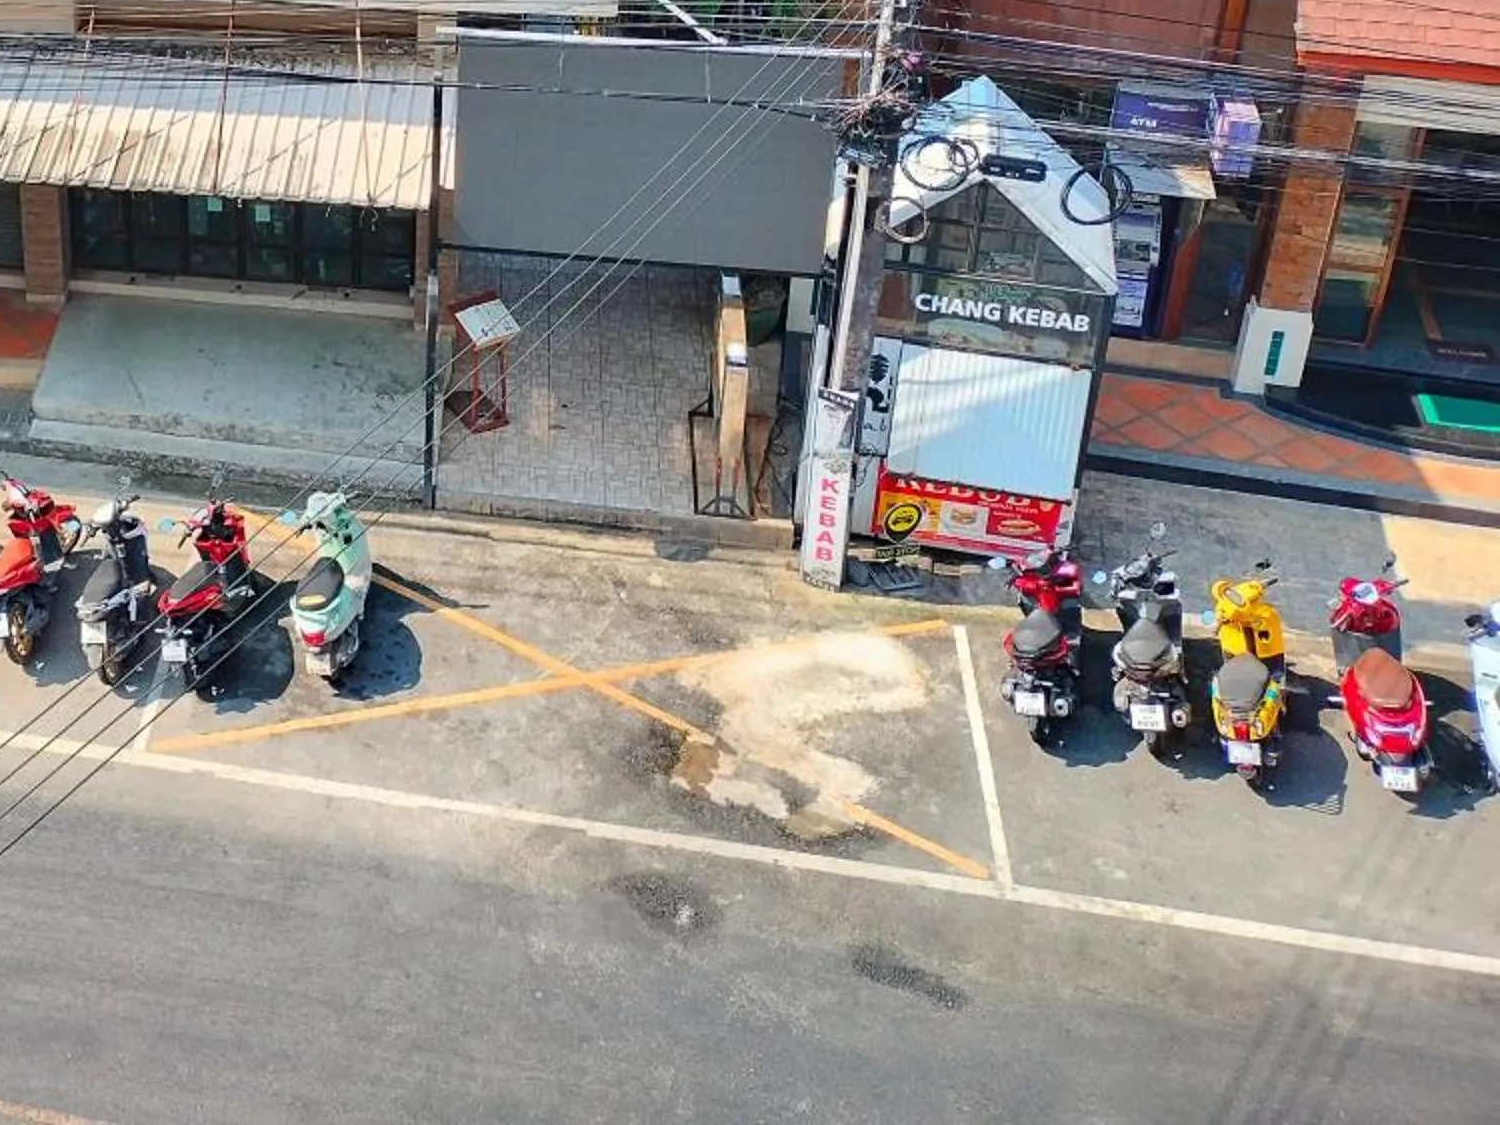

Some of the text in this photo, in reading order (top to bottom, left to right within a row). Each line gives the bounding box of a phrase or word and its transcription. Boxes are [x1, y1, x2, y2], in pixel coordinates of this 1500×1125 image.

[1130, 117, 1157, 128] ATM
[915, 293, 1091, 332] CHANG KEBAB
[815, 478, 839, 562] KEBAB
